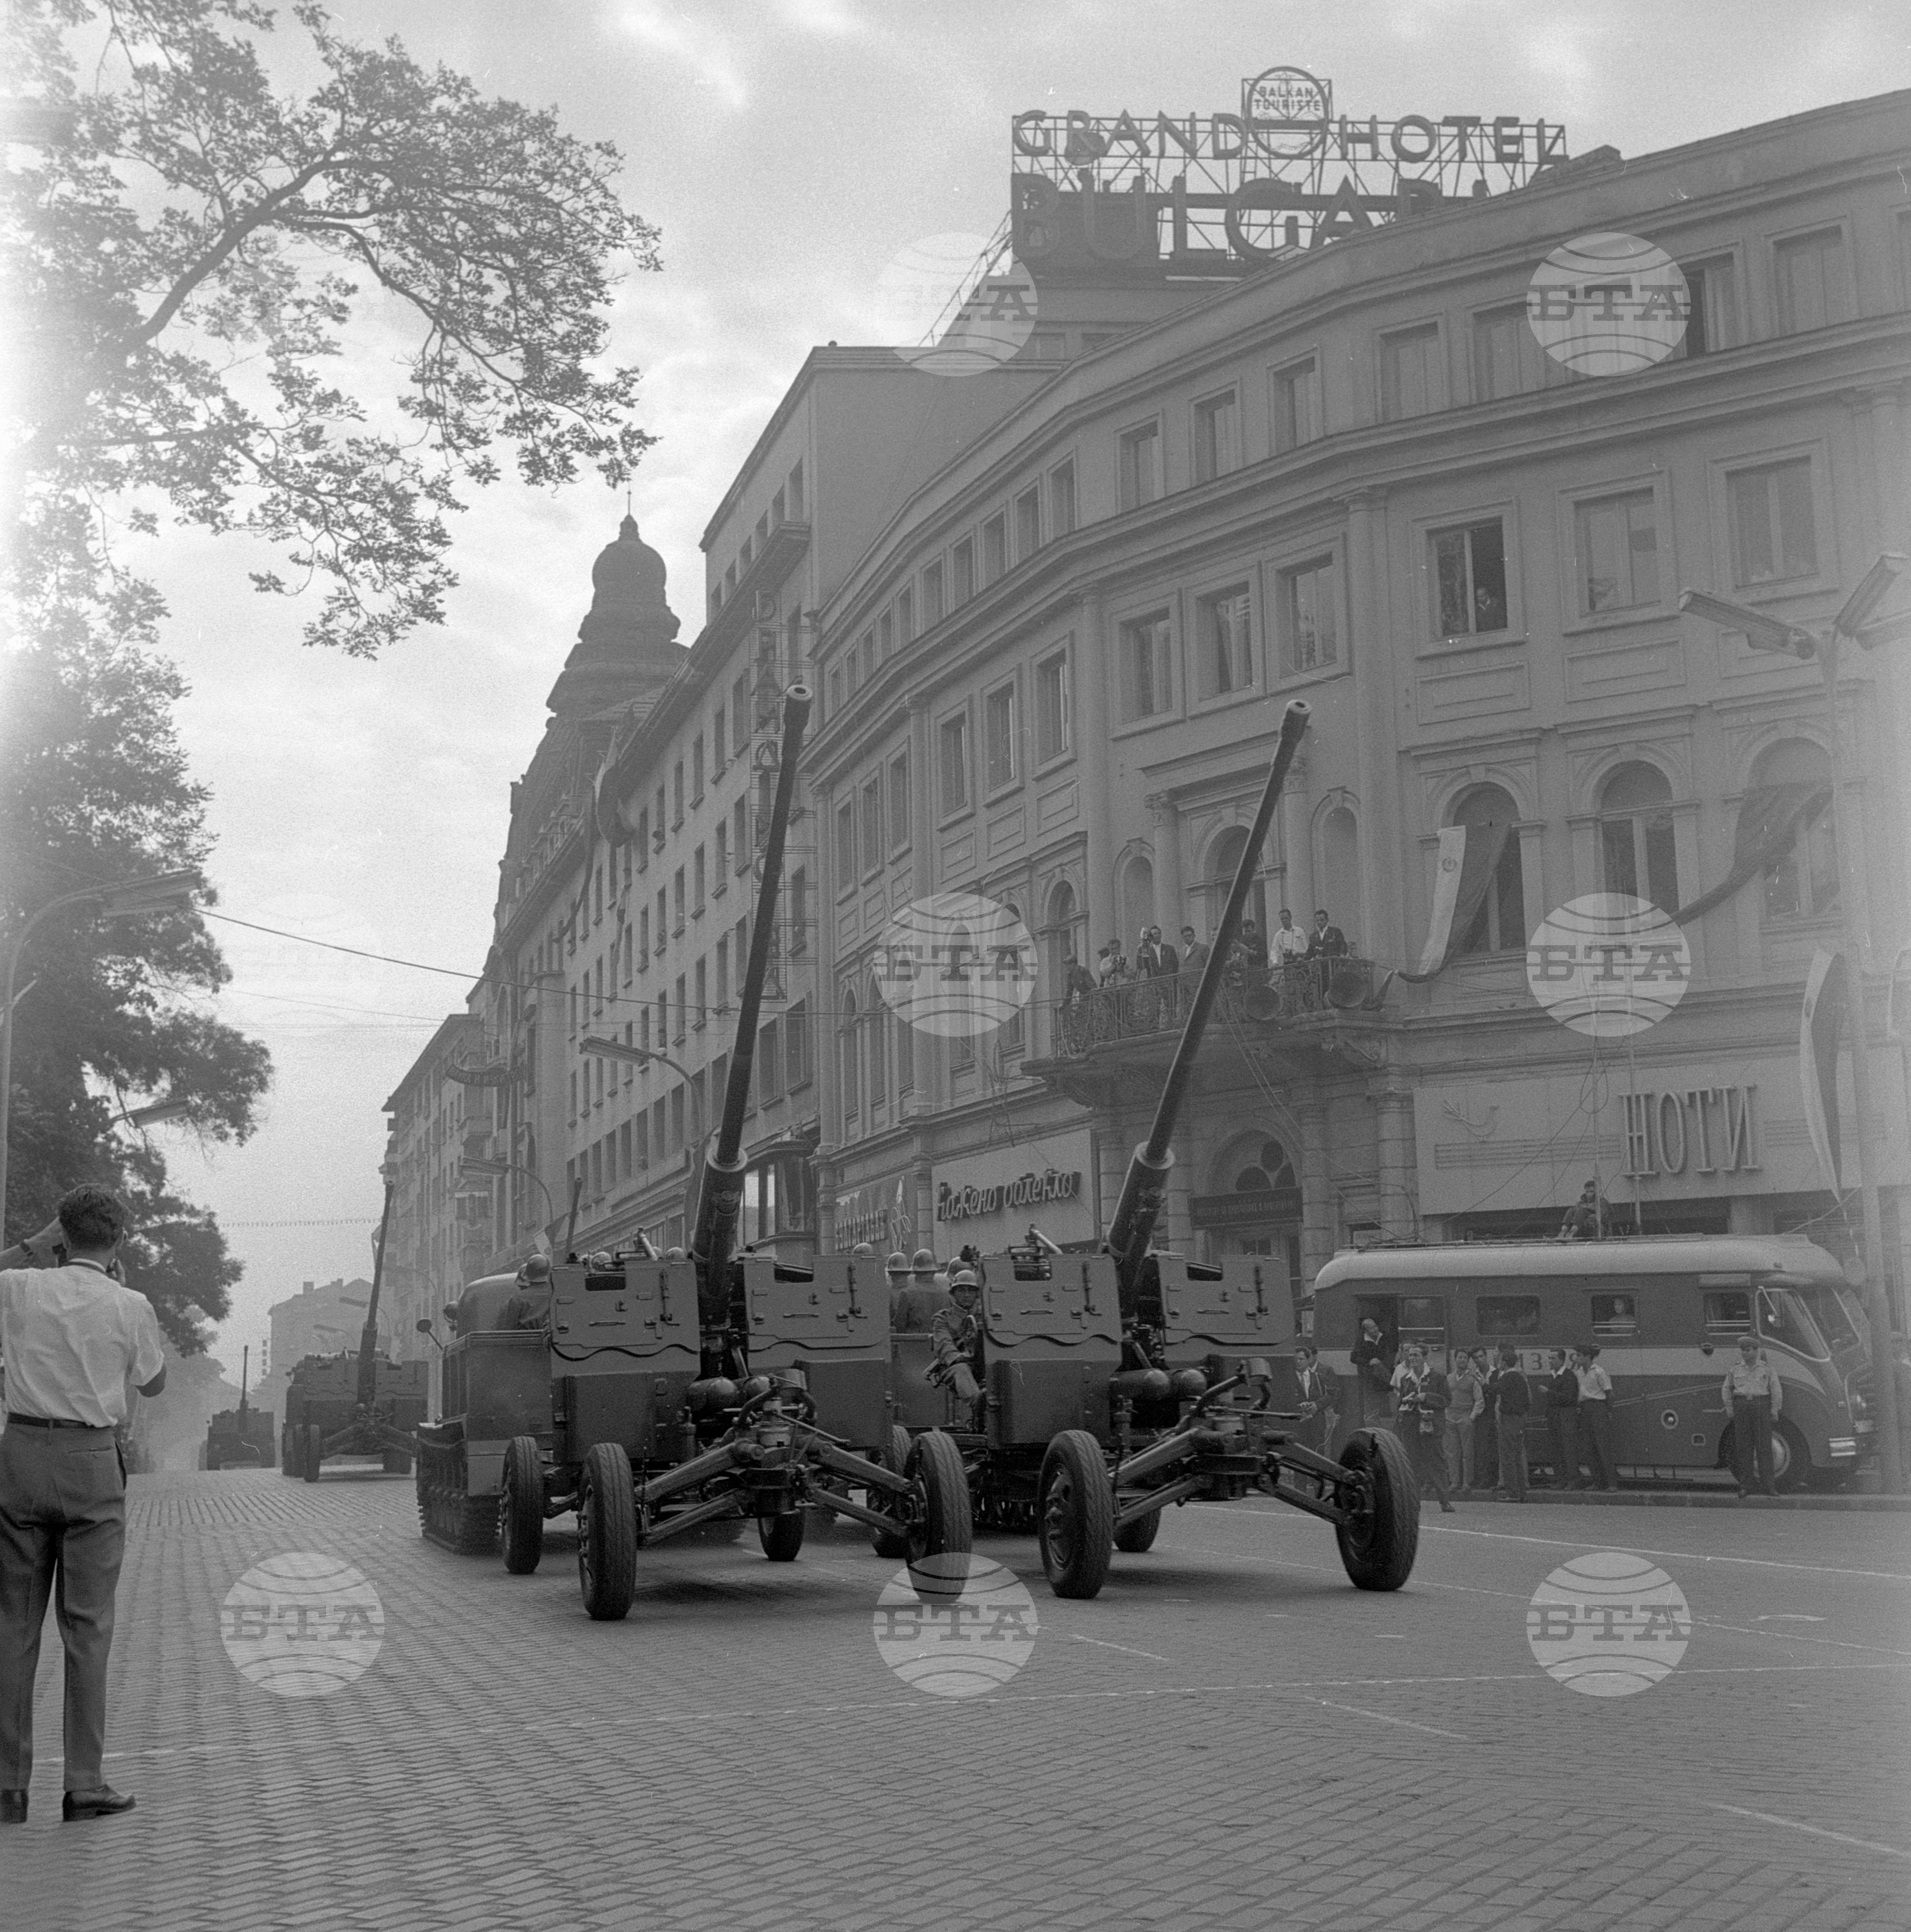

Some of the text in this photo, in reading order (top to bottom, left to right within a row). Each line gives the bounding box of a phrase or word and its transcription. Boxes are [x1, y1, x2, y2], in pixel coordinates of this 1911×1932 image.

[1254, 99, 1321, 112] TOURISTE
[1259, 86, 1313, 98] BALKAN
[1013, 109, 1569, 165] GRAND HOTEL
[1618, 1083, 1761, 1179] НОТИ
